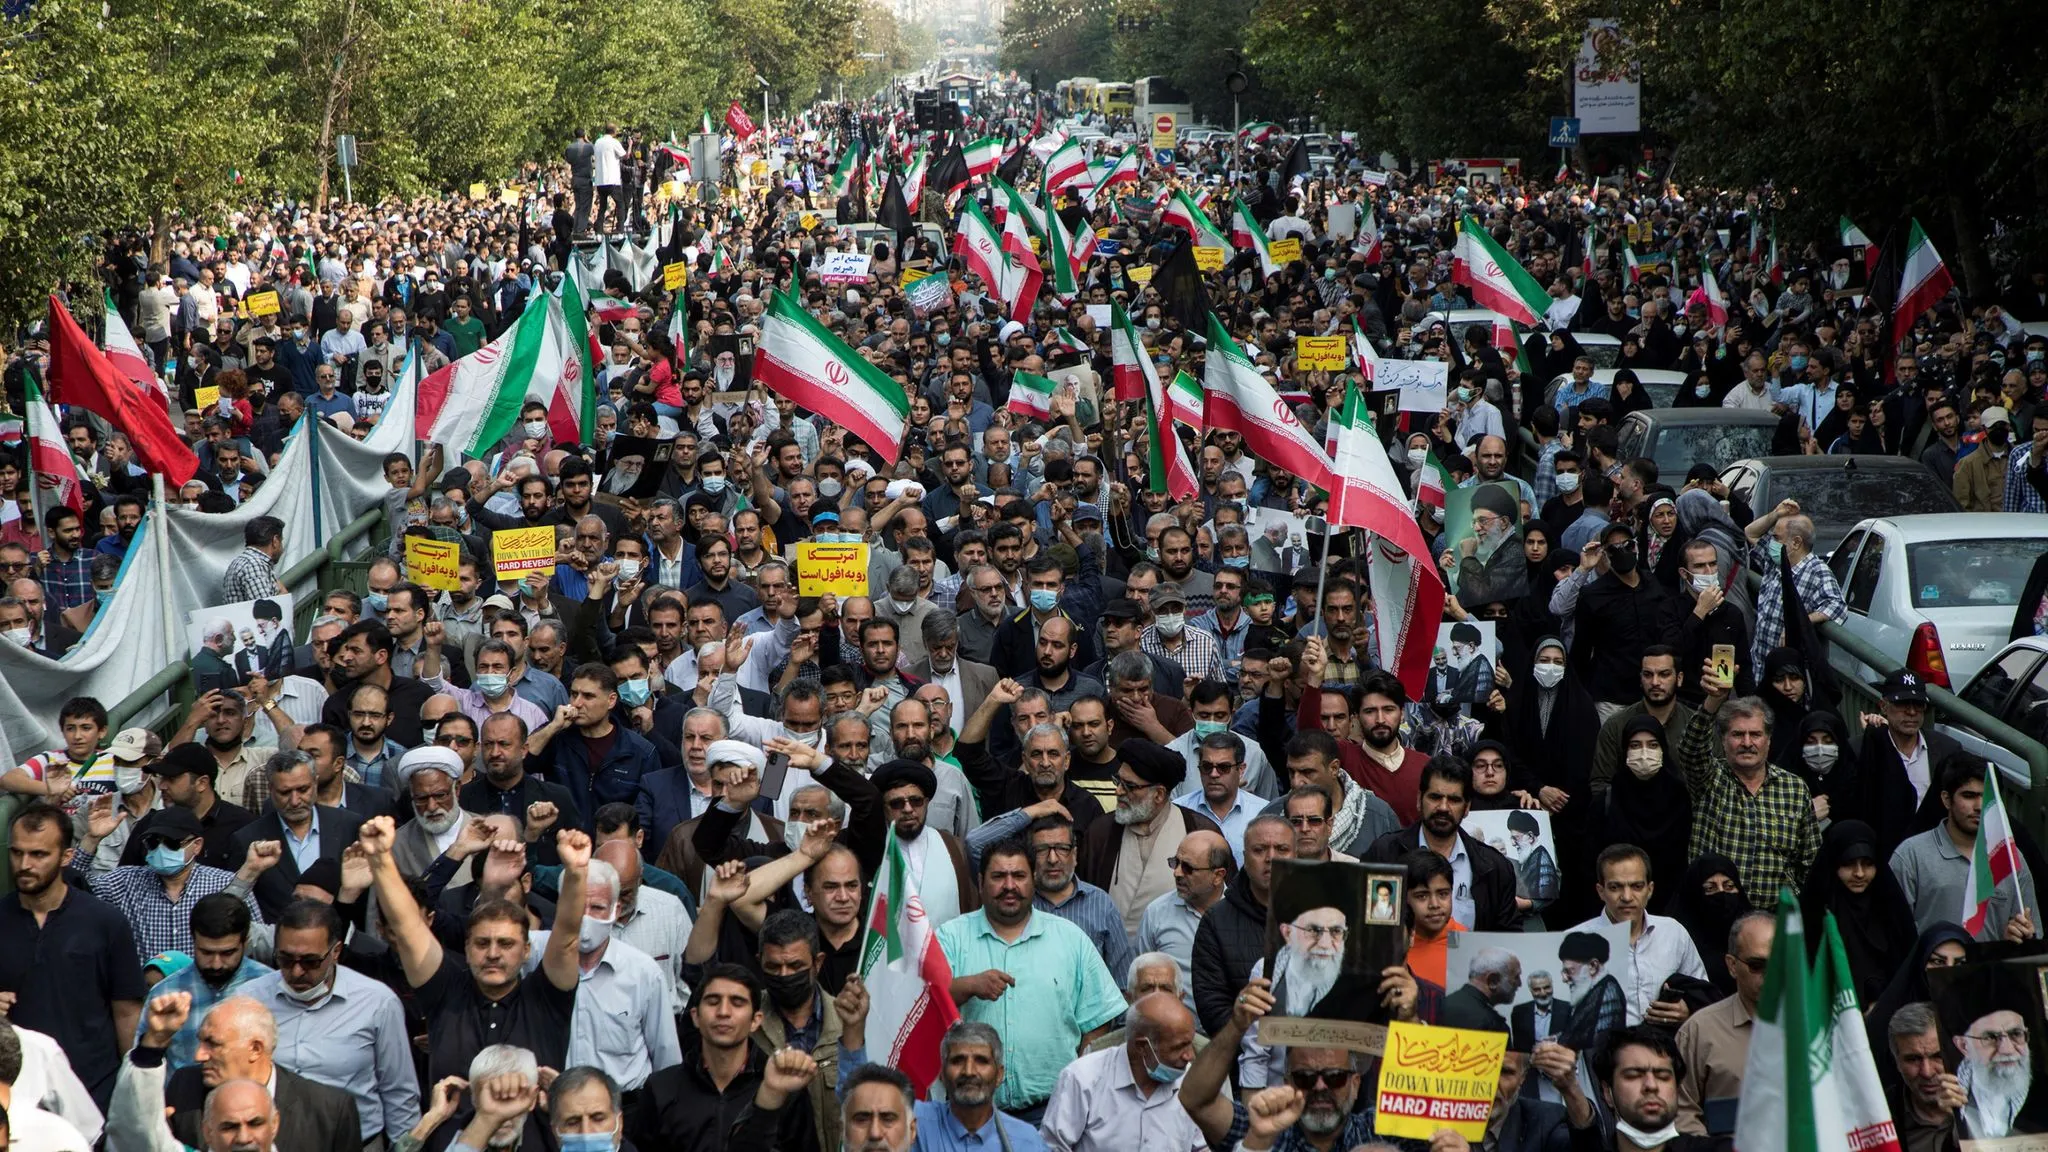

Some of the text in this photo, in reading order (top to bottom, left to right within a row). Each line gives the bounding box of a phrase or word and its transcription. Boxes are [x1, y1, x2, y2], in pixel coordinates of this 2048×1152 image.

[496, 550, 520, 560] DOWN
[521, 548, 540, 558] WITH
[808, 548, 859, 563] آمریکا
[497, 557, 555, 571] HARD REVENGE
[800, 566, 866, 582] رو به افول است
[1950, 643, 1986, 651] RENAULT
[1384, 1071, 1493, 1098] DOWN WITH USA
[1380, 1093, 1490, 1120] HARD REVENGE
